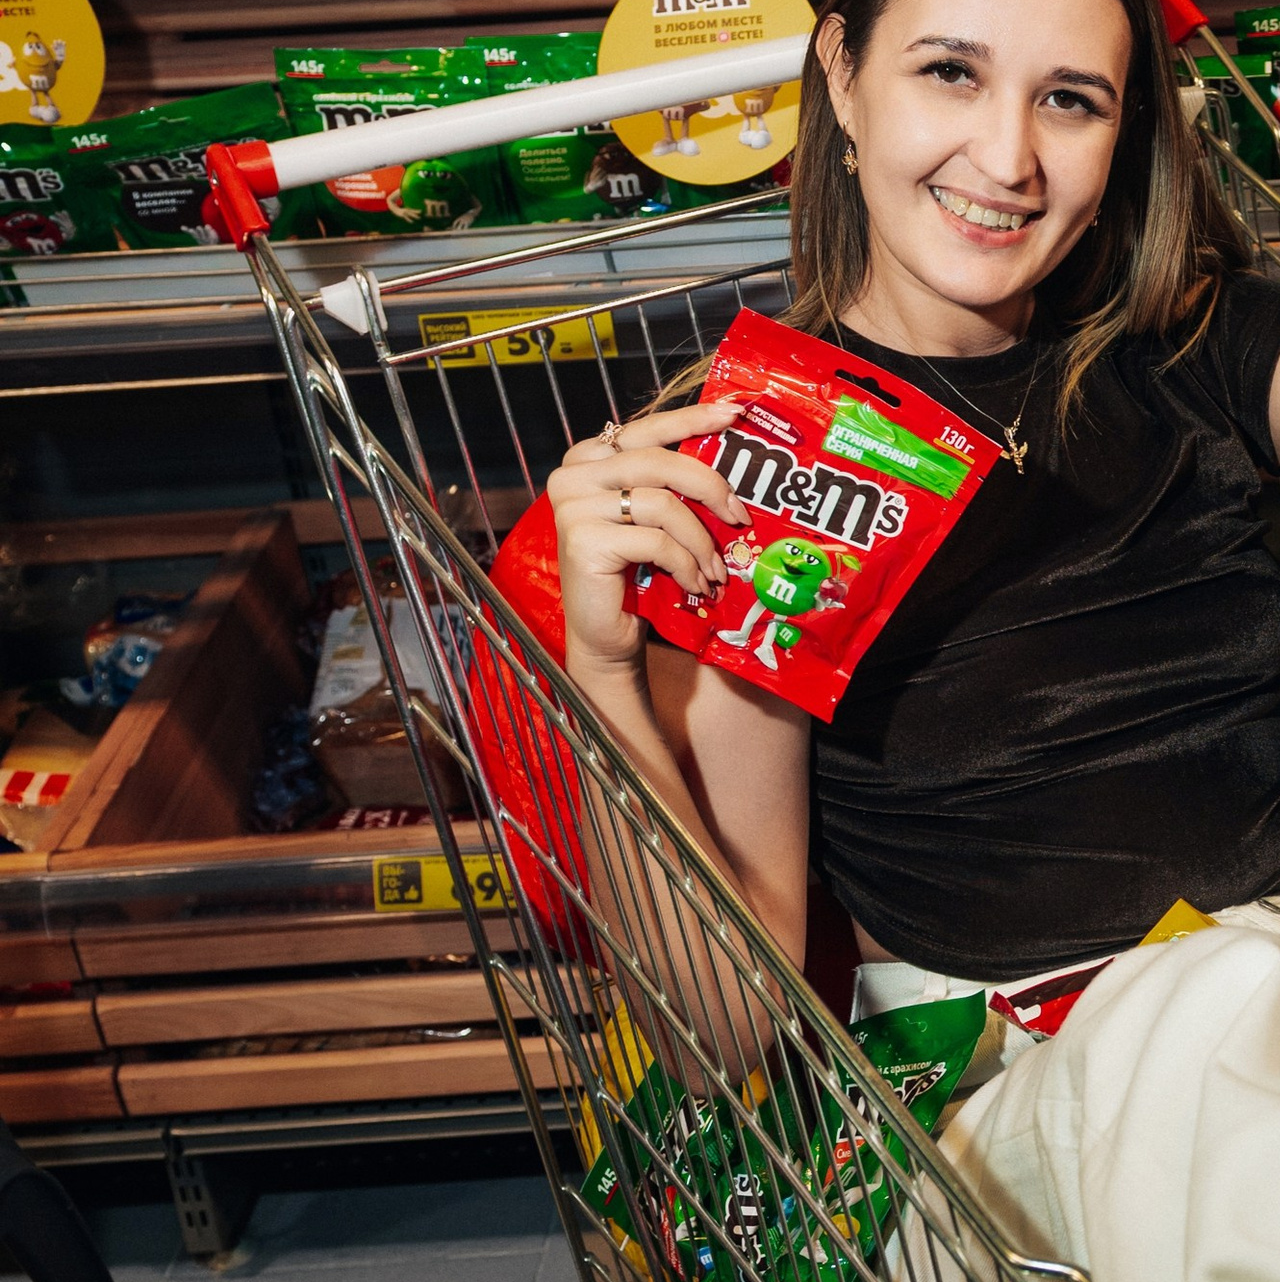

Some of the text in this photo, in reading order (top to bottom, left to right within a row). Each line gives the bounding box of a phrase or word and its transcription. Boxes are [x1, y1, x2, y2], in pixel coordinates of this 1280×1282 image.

[654, 15, 763, 34] В ЛЮБОМ МЕСТЕ
[654, 34, 707, 48] ВЕСЕЛЕЕ
[290, 59, 326, 73] 145г
[483, 48, 518, 62] 145г
[71, 133, 108, 149] 145г
[507, 327, 556, 357] 59
[751, 404, 791, 432] ХРУСТЯЩИЙ
[772, 426, 797, 445] ВИШНИ
[825, 434, 865, 461] СЕРИЯ
[832, 422, 919, 471] ОГРАНИЧЕННАЯ
[939, 424, 974, 457] 130г
[717, 430, 905, 548] m&m's
[597, 1167, 618, 1195] 145
